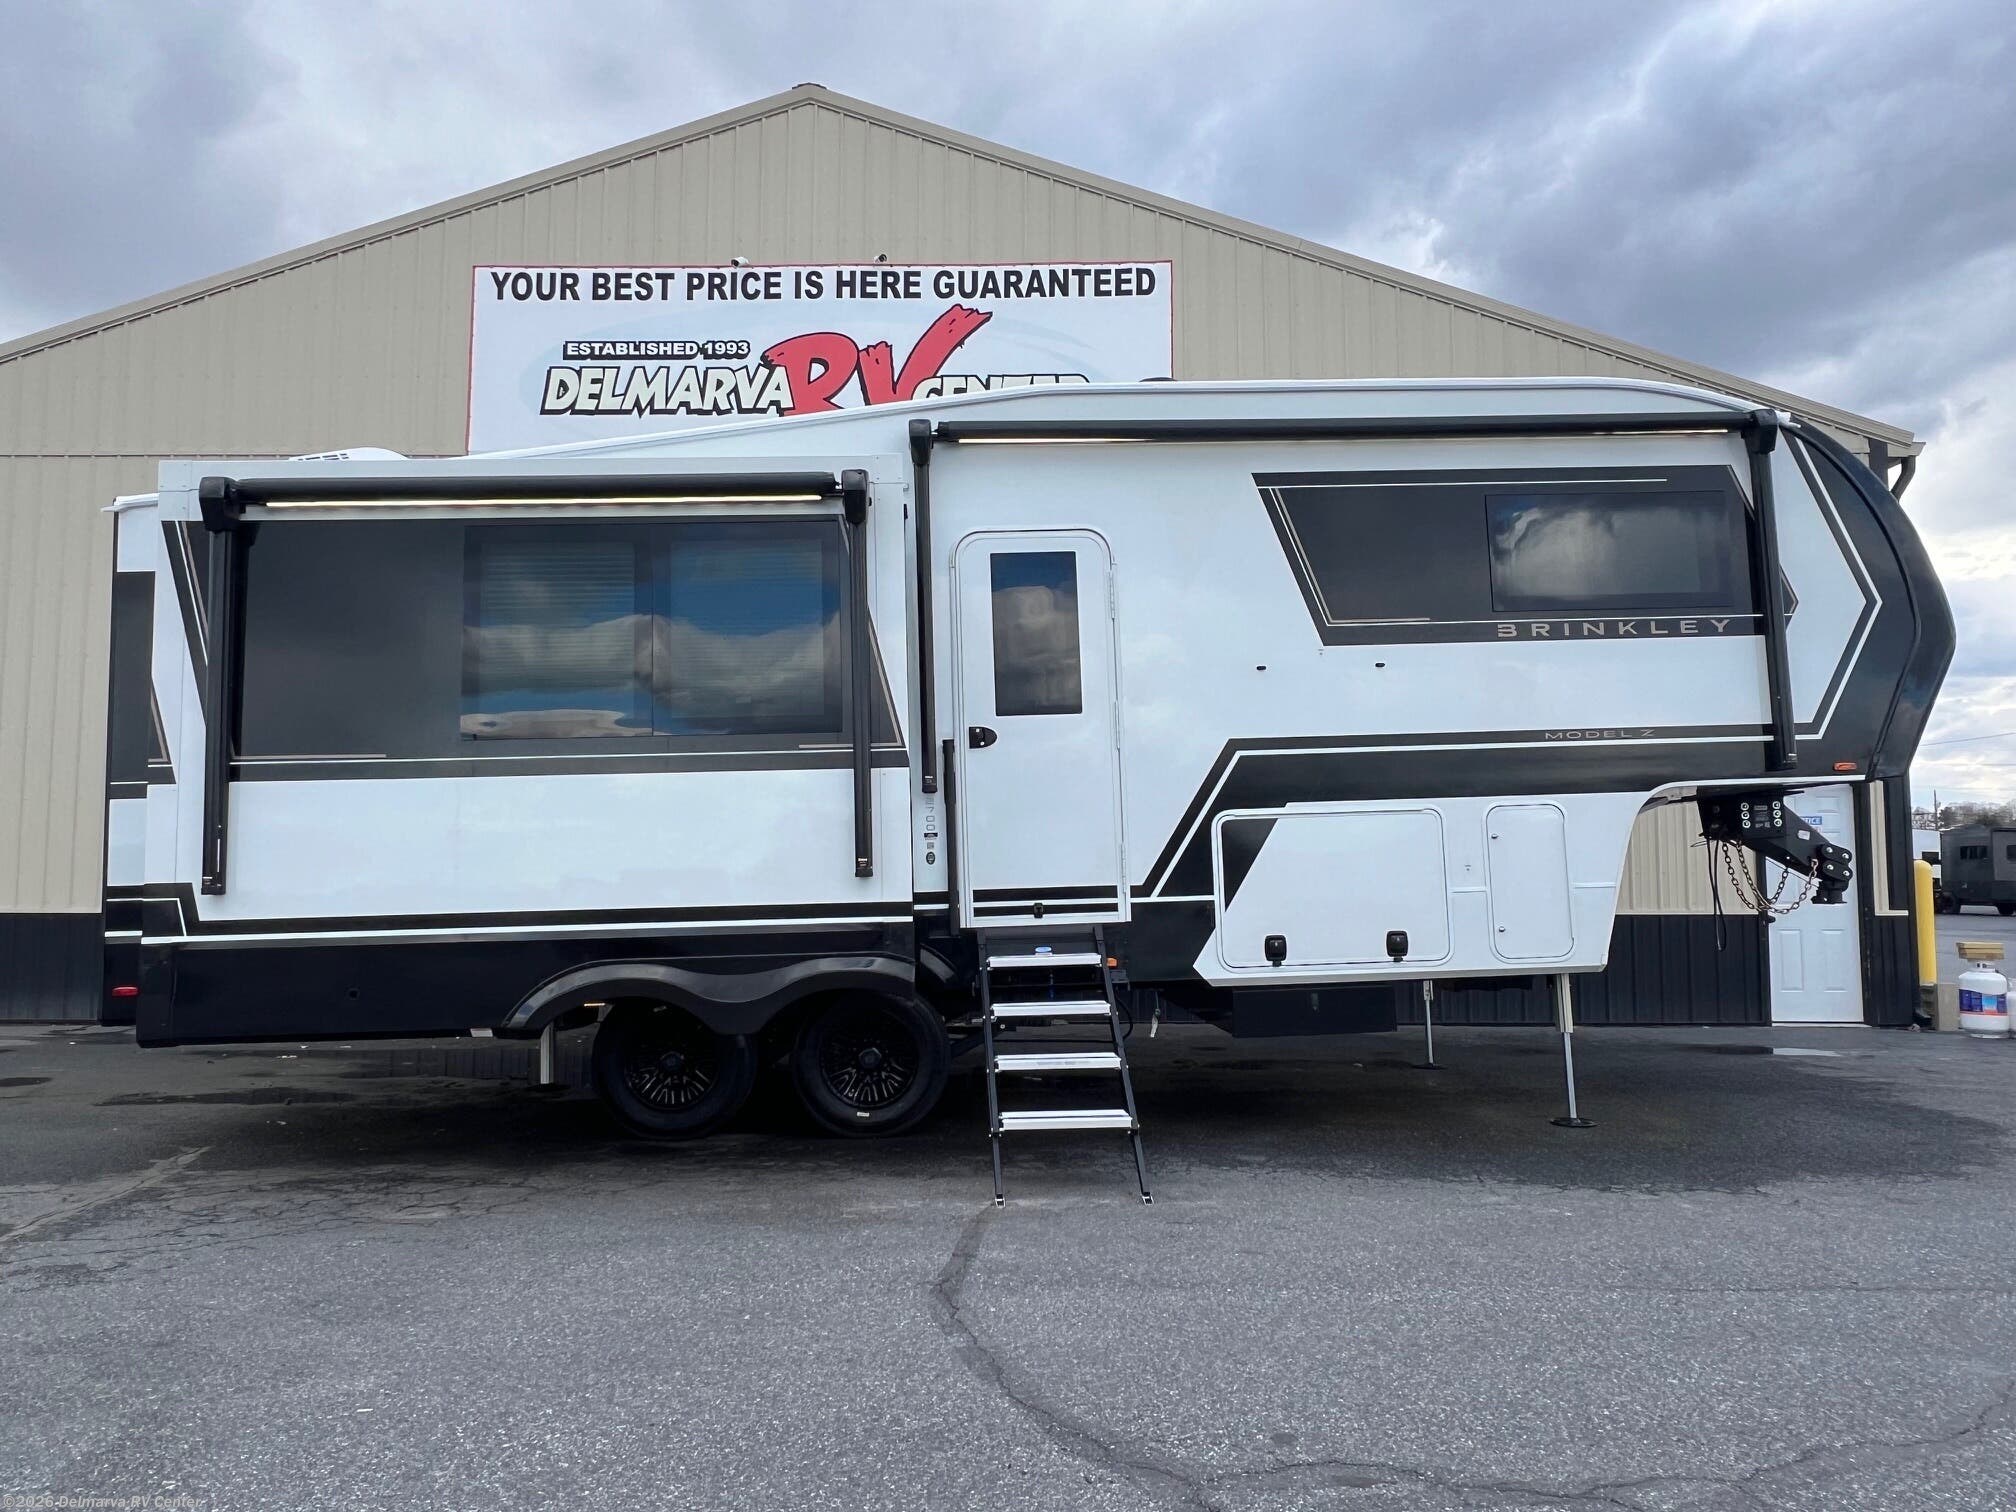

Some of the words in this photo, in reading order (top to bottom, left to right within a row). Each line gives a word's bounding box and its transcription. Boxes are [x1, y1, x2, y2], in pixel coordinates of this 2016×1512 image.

[490, 271, 580, 301] YOUR
[591, 271, 675, 301] BEST
[686, 271, 782, 301] PRICE
[794, 270, 824, 300] IS
[835, 269, 922, 299] HERE
[932, 267, 1157, 299] GUARANTEED
[565, 341, 700, 357] ESTABLISHED
[704, 340, 751, 356] 1993
[541, 365, 793, 416] DELMARVA
[761, 303, 993, 416] RV
[1496, 618, 1731, 638] BRINKLEY
[1544, 729, 1633, 740] MODEL
[1640, 728, 1656, 738] Z
